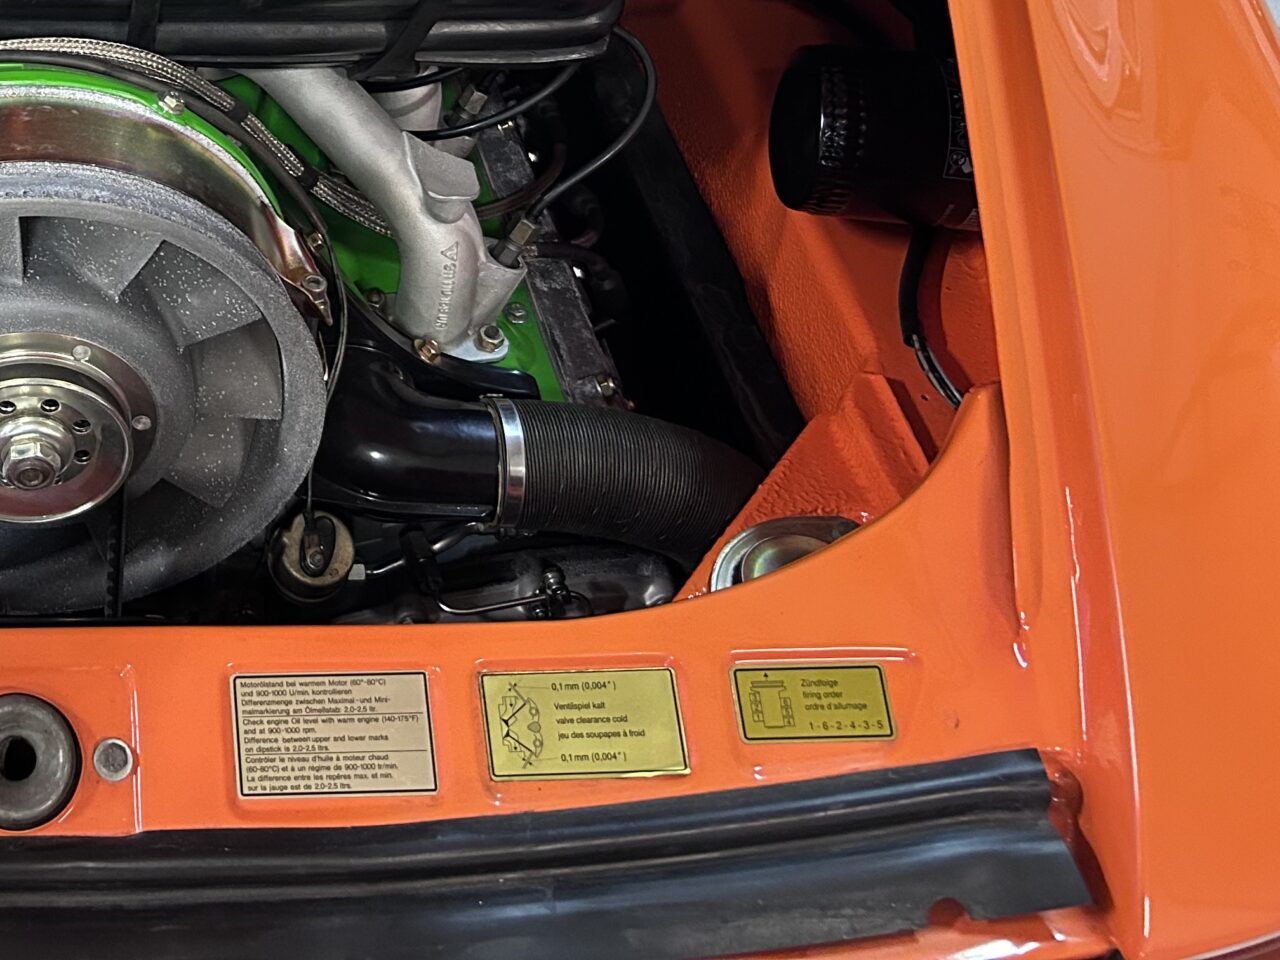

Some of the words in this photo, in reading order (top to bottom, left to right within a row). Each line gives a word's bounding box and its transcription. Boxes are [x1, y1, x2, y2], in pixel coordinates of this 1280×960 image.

[554, 702, 590, 711] Ventilspiel
[592, 701, 605, 709] kalt
[243, 718, 264, 726] Check
[556, 716, 574, 724] valve
[576, 715, 611, 724] clearance
[612, 714, 628, 723] cold
[558, 731, 569, 741] jeu
[571, 730, 584, 739] des
[586, 730, 621, 740] soupapes
[629, 728, 645, 737] froid
[312, 736, 330, 744] upper
[368, 753, 389, 761] chaud
[333, 763, 342, 771] de
